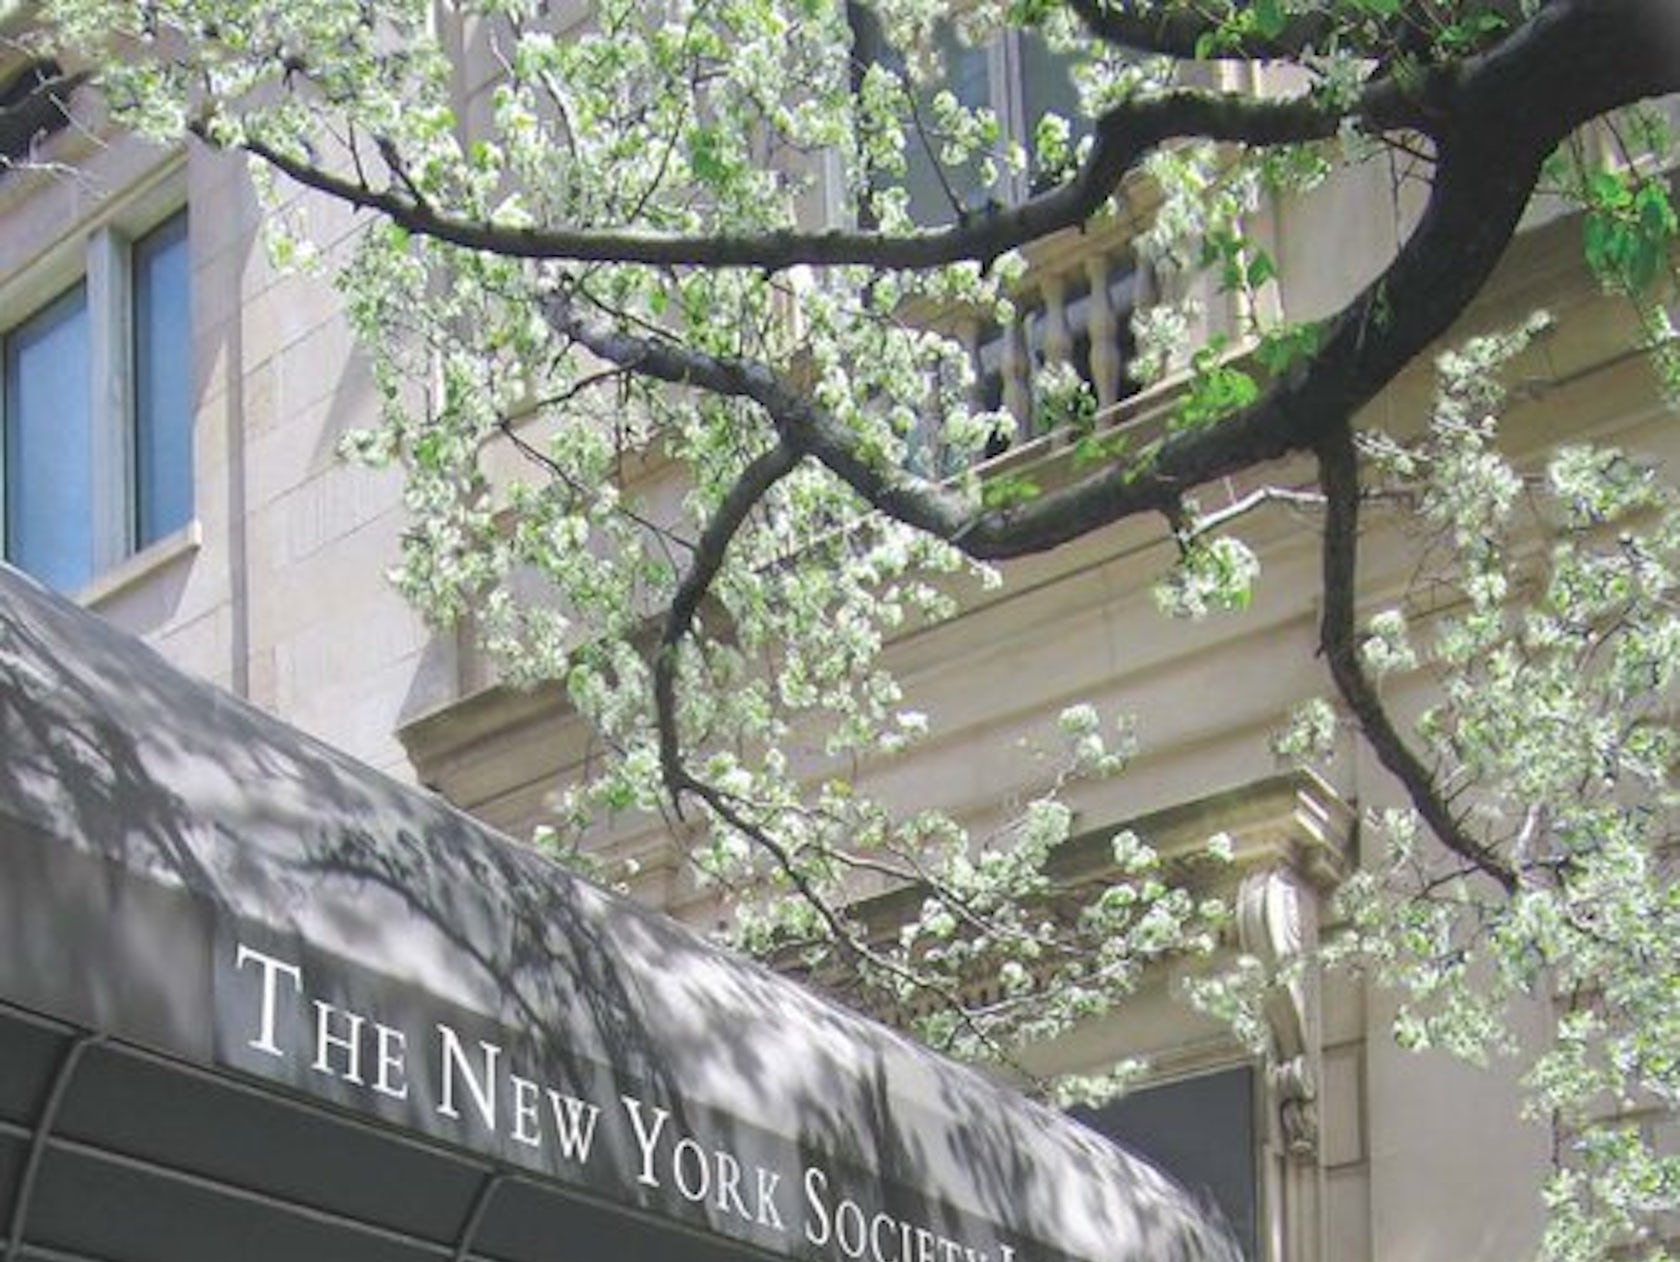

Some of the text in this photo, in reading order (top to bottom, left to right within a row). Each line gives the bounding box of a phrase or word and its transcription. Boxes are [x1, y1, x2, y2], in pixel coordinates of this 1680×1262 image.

[236, 944, 408, 1099] THE
[436, 1023, 601, 1164] NEW
[622, 1095, 786, 1232] YORK
